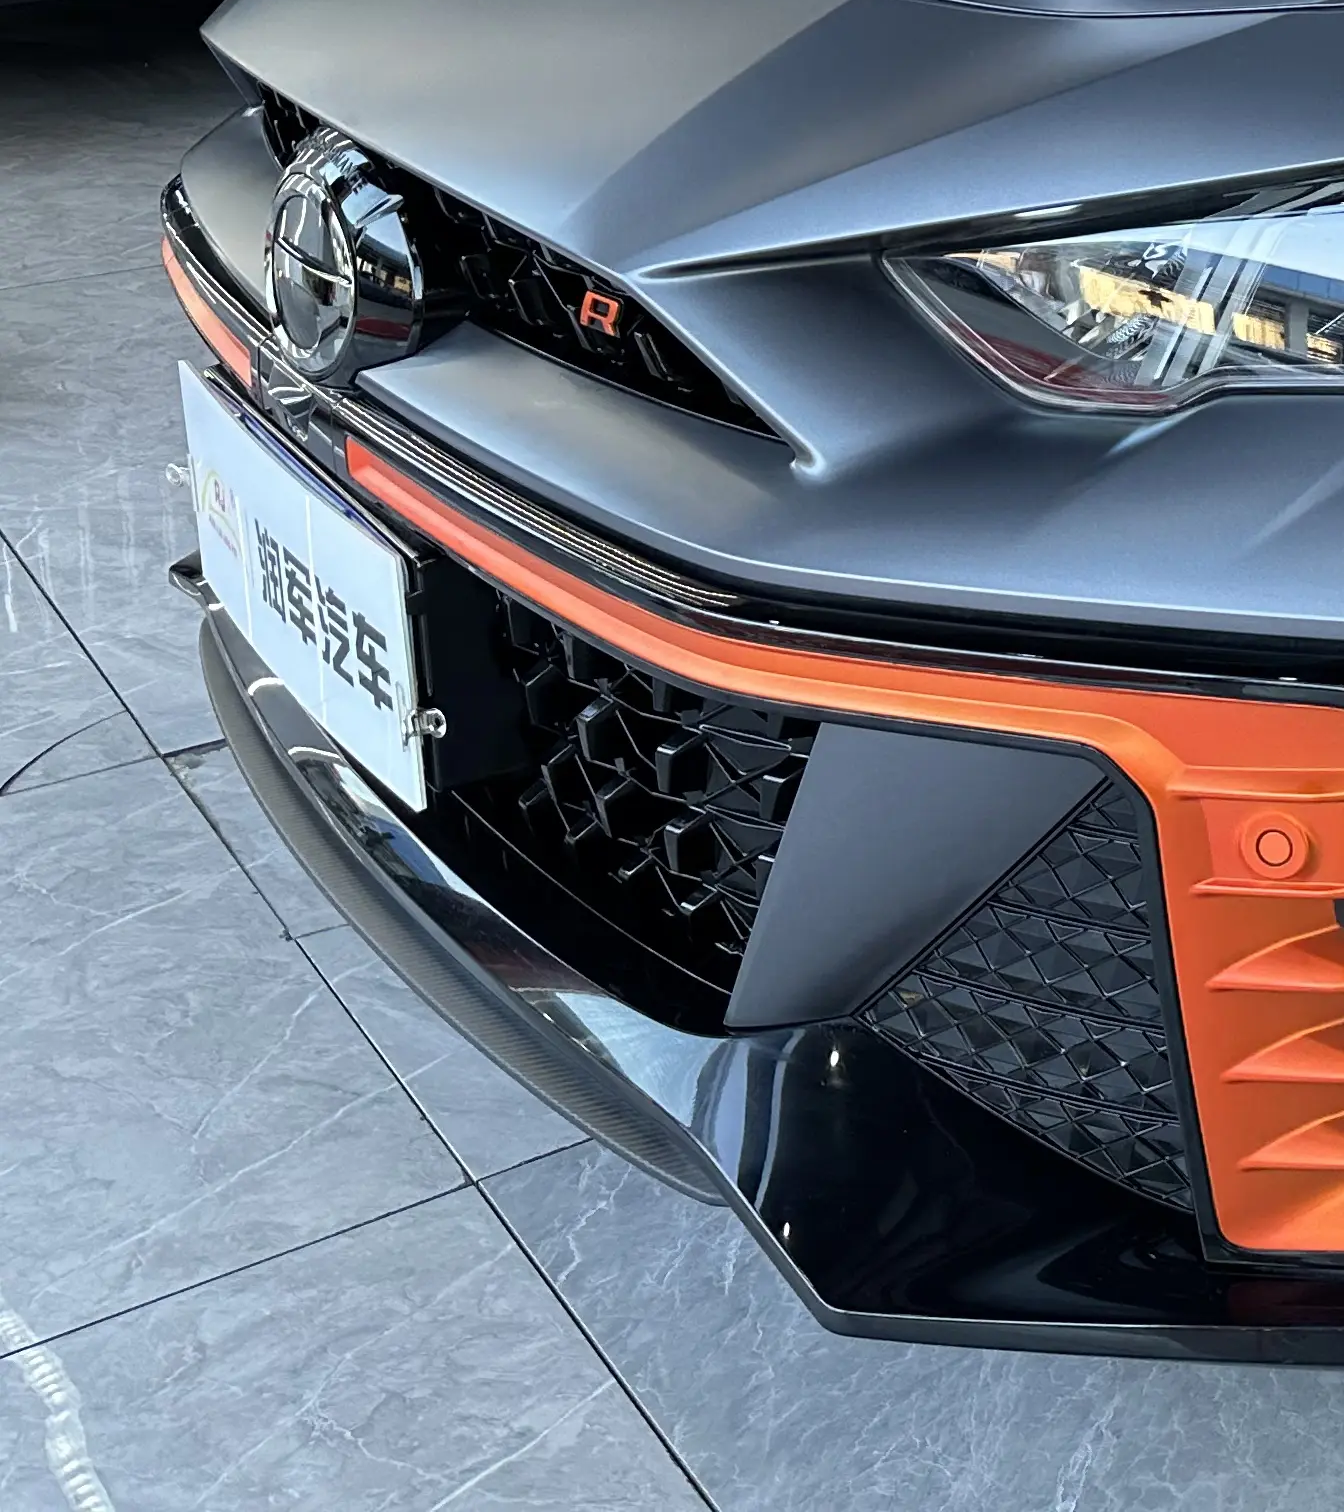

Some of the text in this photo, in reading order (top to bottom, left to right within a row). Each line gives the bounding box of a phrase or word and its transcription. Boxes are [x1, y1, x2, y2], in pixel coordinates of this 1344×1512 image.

[580, 290, 620, 338] R
[254, 517, 394, 712] 润军汽车
